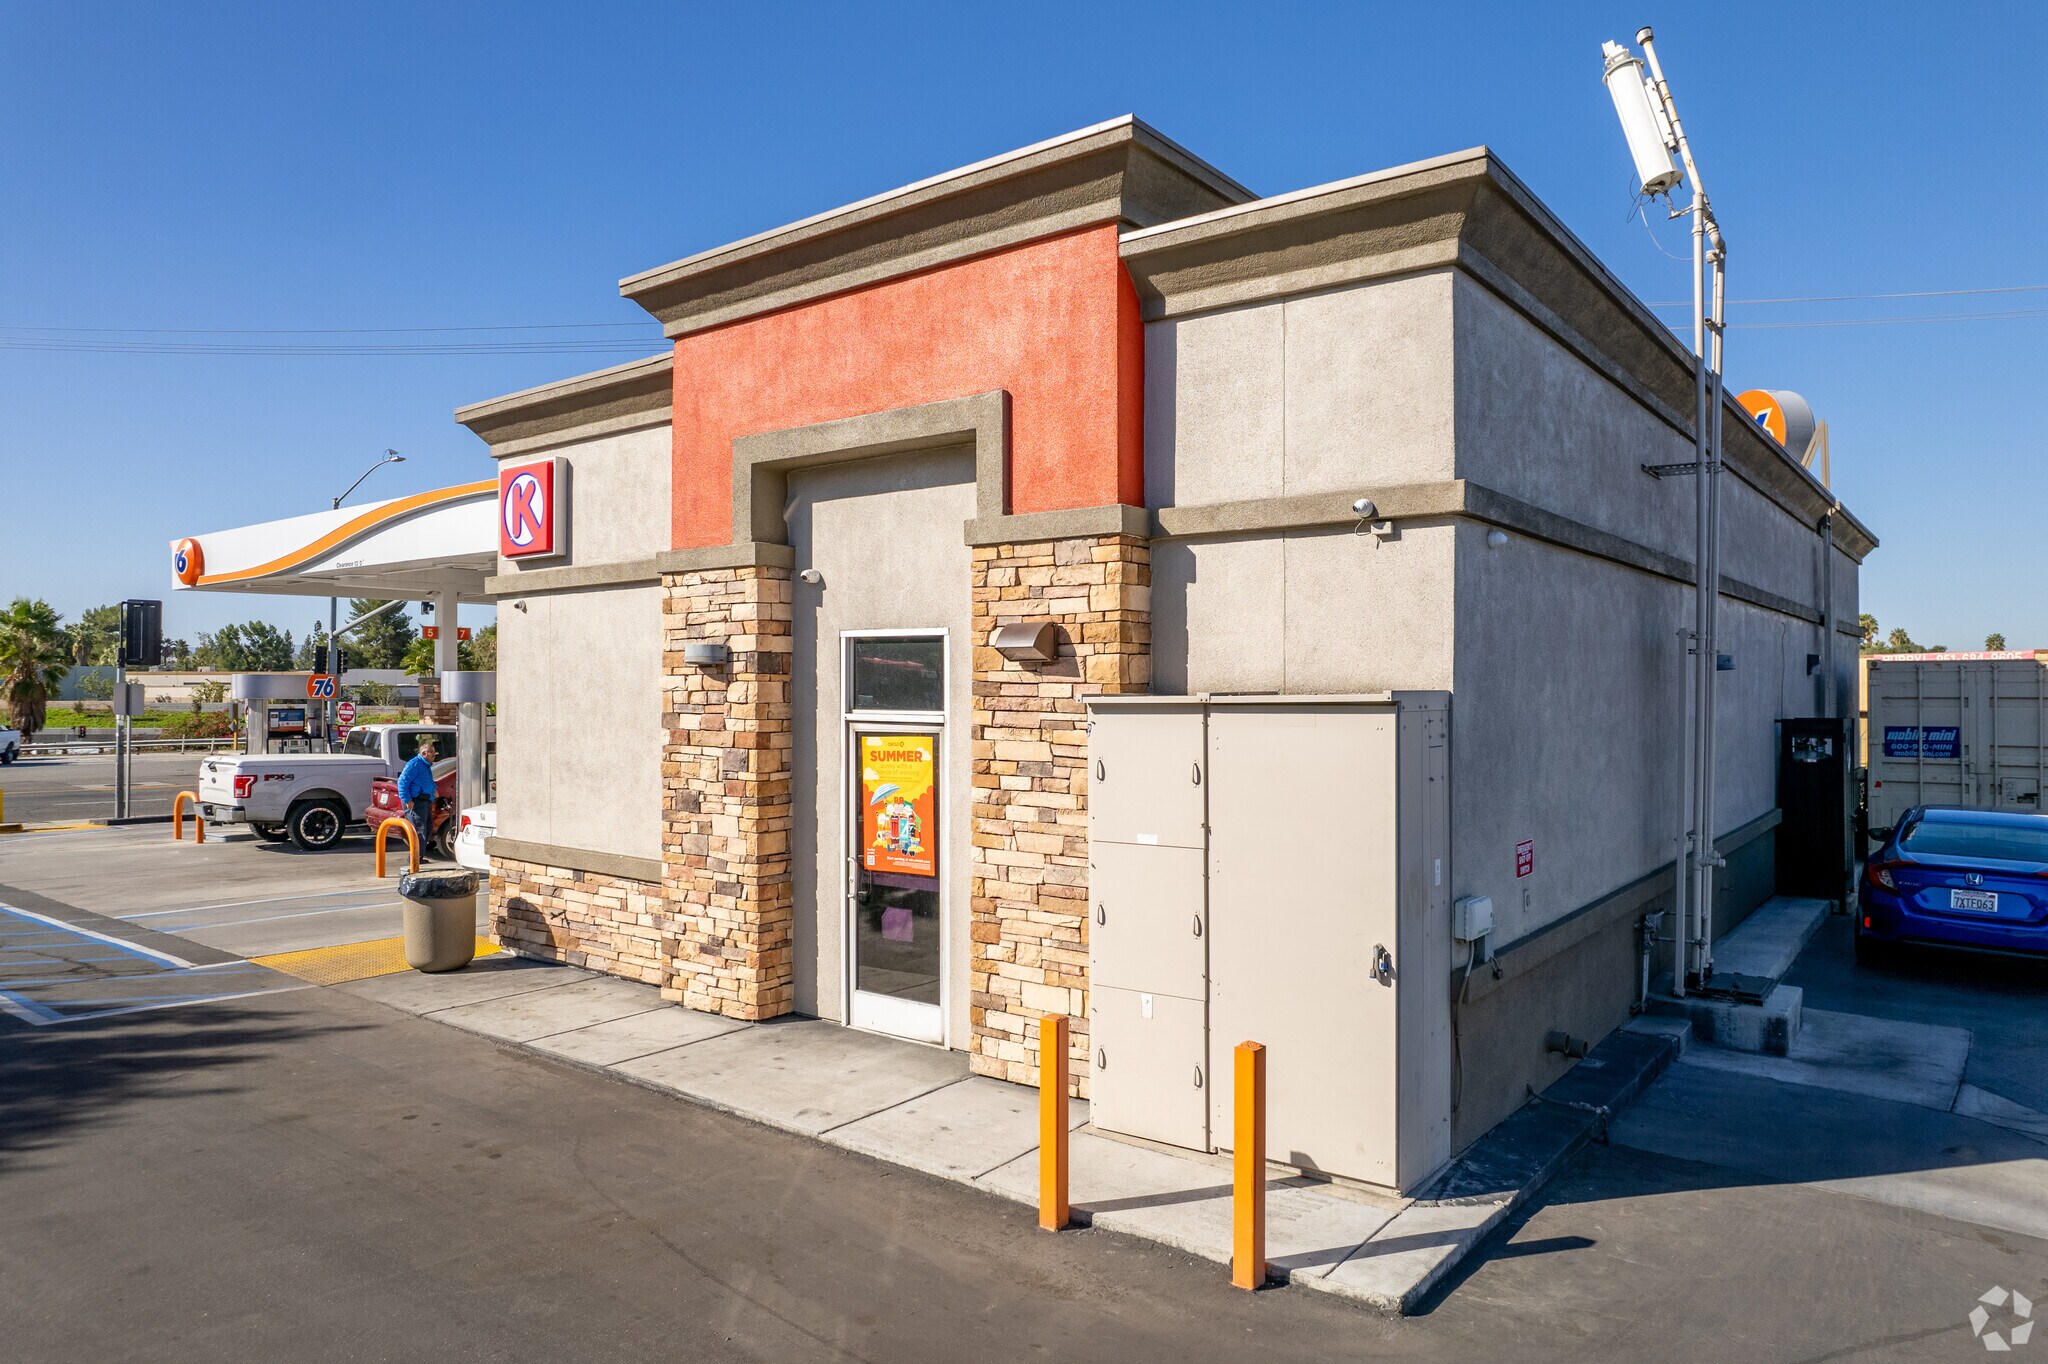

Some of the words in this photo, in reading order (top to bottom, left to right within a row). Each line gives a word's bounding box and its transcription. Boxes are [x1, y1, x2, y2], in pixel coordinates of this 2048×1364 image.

[512, 480, 541, 541] K
[174, 549, 187, 573] 6
[427, 628, 434, 638] 5
[460, 629, 466, 639] 7
[312, 676, 335, 698] 76
[1928, 729, 1957, 741] mini
[1891, 743, 1953, 751] 800-90-MINI
[870, 750, 923, 762] SUMMER
